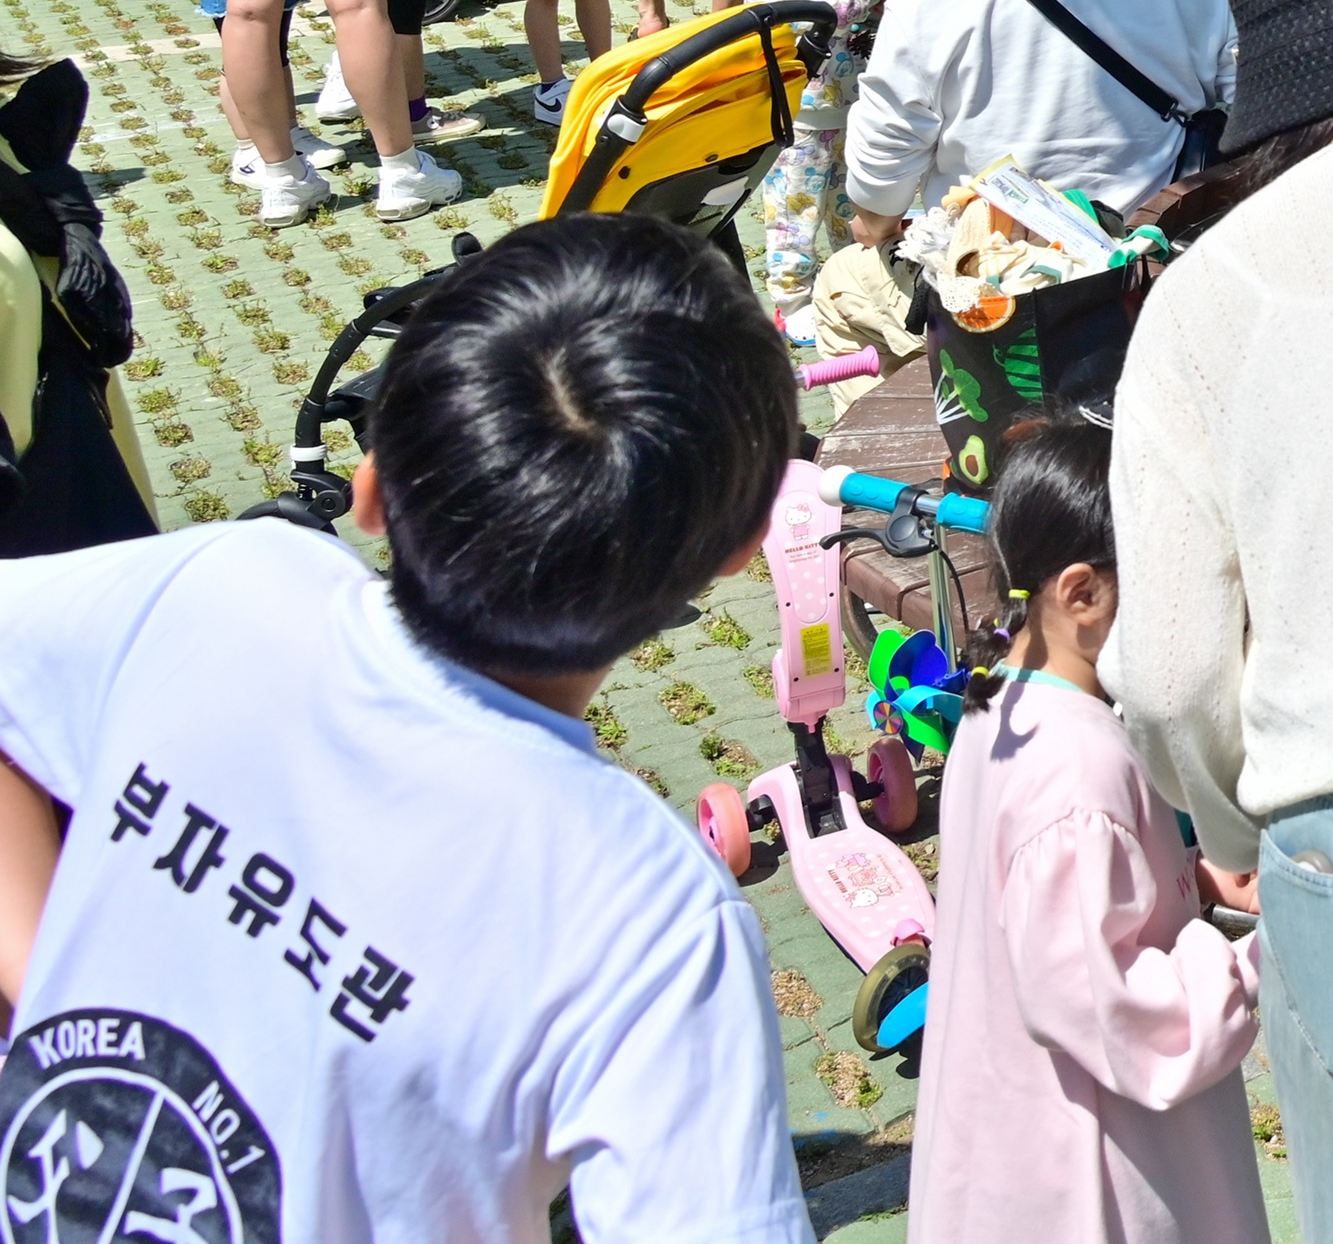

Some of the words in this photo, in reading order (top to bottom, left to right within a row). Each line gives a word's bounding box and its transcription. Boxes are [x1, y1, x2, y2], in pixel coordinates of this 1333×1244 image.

[110, 762, 415, 1044] 부자유도관
[28, 1018, 146, 1069] KOREA
[192, 1080, 266, 1174] NO.1
